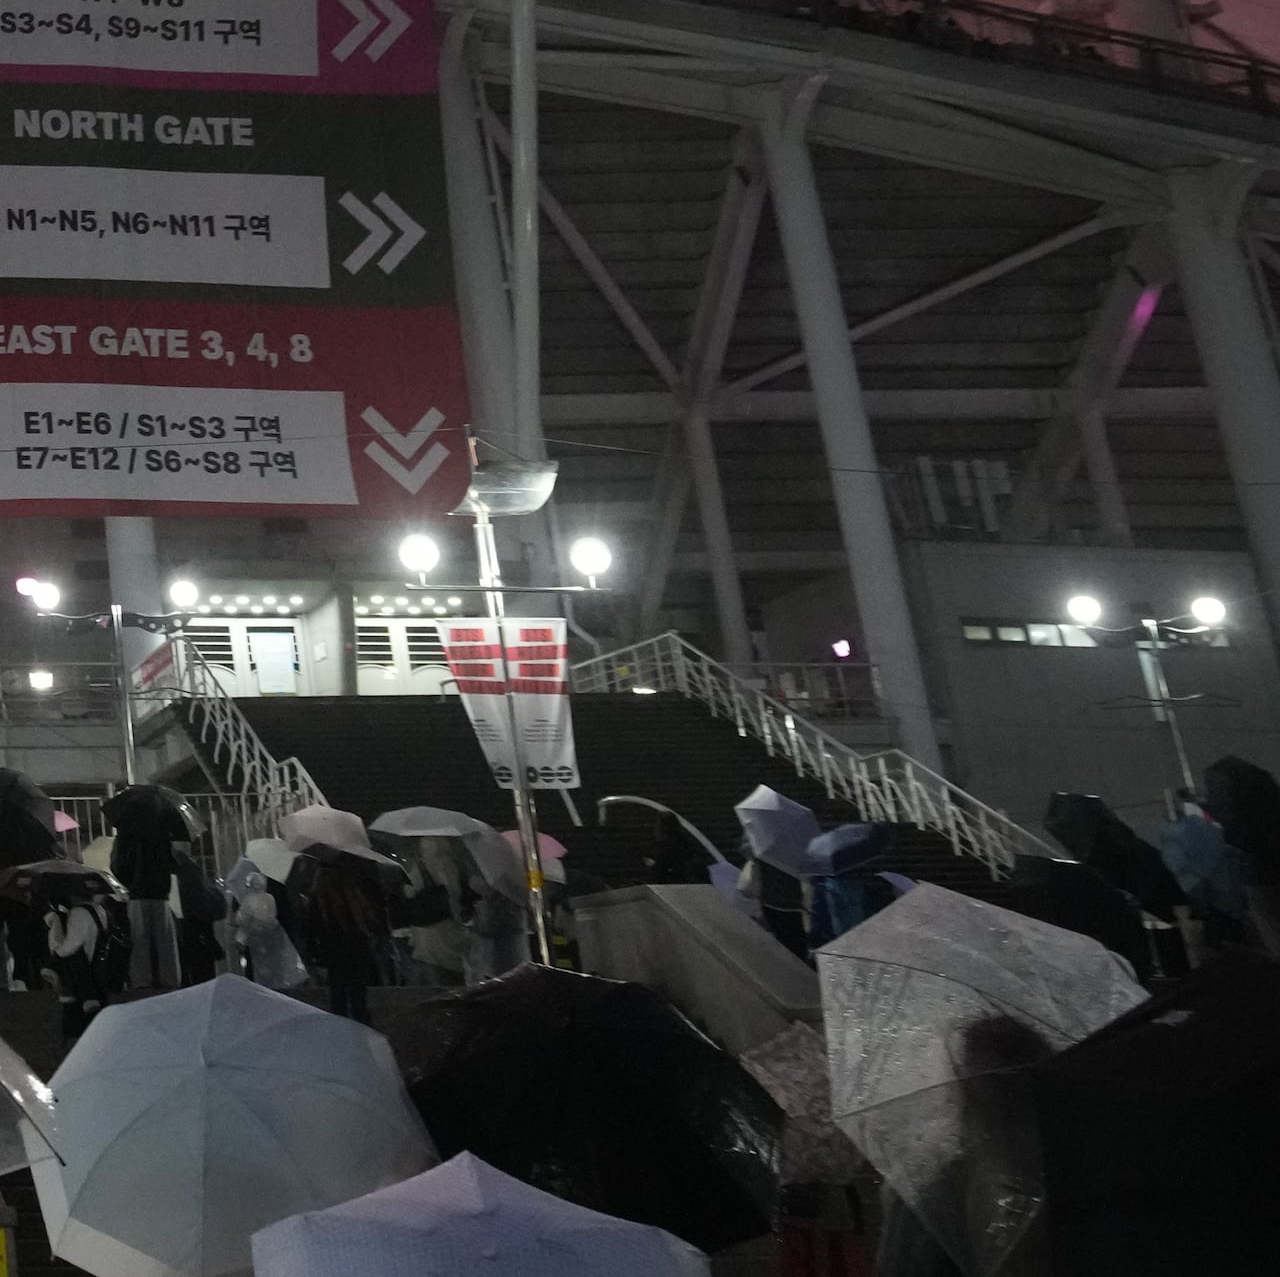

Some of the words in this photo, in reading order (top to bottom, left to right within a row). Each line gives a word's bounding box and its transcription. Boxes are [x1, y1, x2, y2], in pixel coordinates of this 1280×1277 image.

[0, 11, 100, 42] S3~S4,
[108, 15, 205, 41] S9~S11
[213, 19, 261, 46] 구역
[14, 109, 144, 142] NORTH
[155, 114, 255, 146] GATE
[7, 208, 106, 238] N1~N5,
[112, 211, 215, 237] N6~N11
[224, 214, 271, 242] 구역
[89, 326, 189, 359] GATE
[200, 330, 235, 367] 3,
[246, 332, 279, 368] 4,
[290, 334, 313, 363] 8
[24, 411, 111, 435] E1~E6
[119, 412, 129, 439] /
[137, 414, 226, 439] S1~S3
[232, 415, 282, 444] 구역
[16, 447, 120, 470] E7~E12
[127, 448, 137, 474] /
[145, 450, 240, 474] S6~S8
[249, 450, 298, 479] 구역
